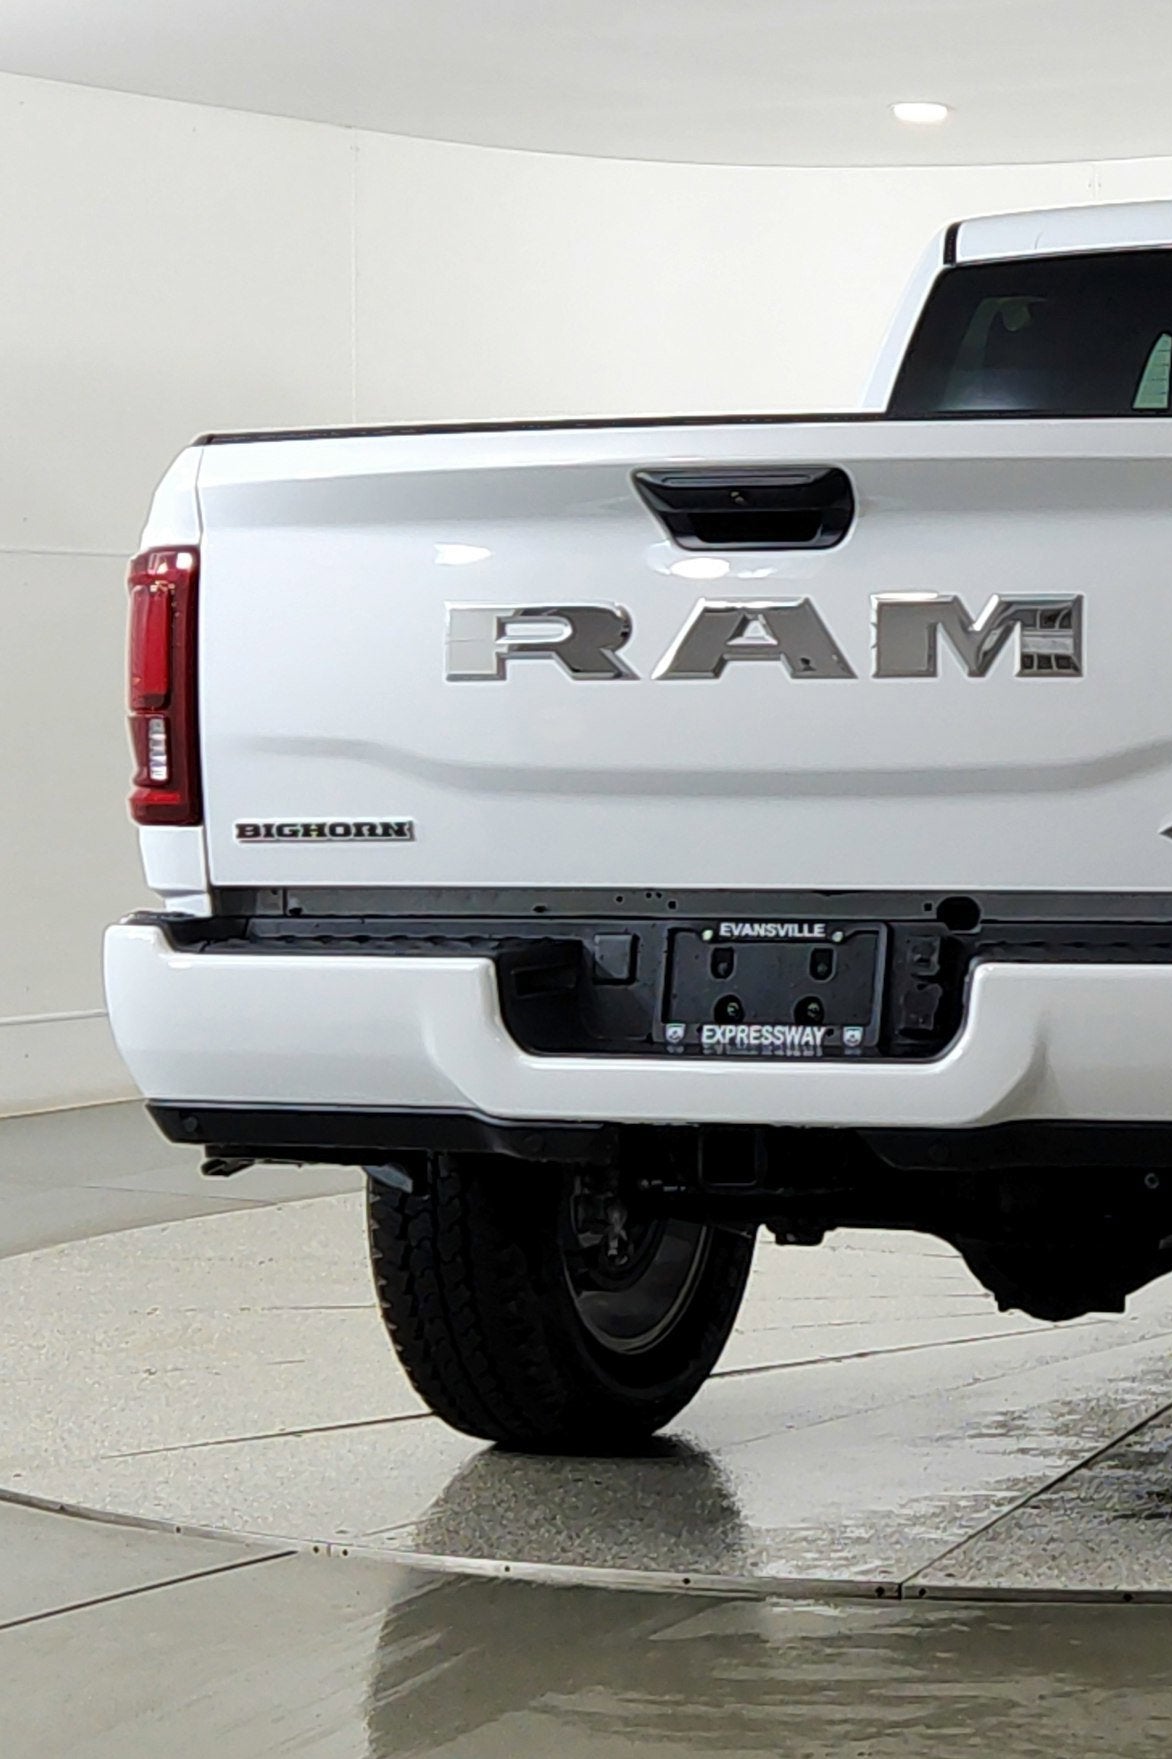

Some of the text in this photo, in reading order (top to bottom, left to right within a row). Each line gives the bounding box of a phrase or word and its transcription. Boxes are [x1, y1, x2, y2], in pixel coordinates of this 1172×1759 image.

[446, 592, 1084, 681] RAM
[235, 819, 415, 843] BIGHORN
[718, 921, 827, 938] EVANSVILLE
[701, 1024, 827, 1045] EXPRESSWAY
